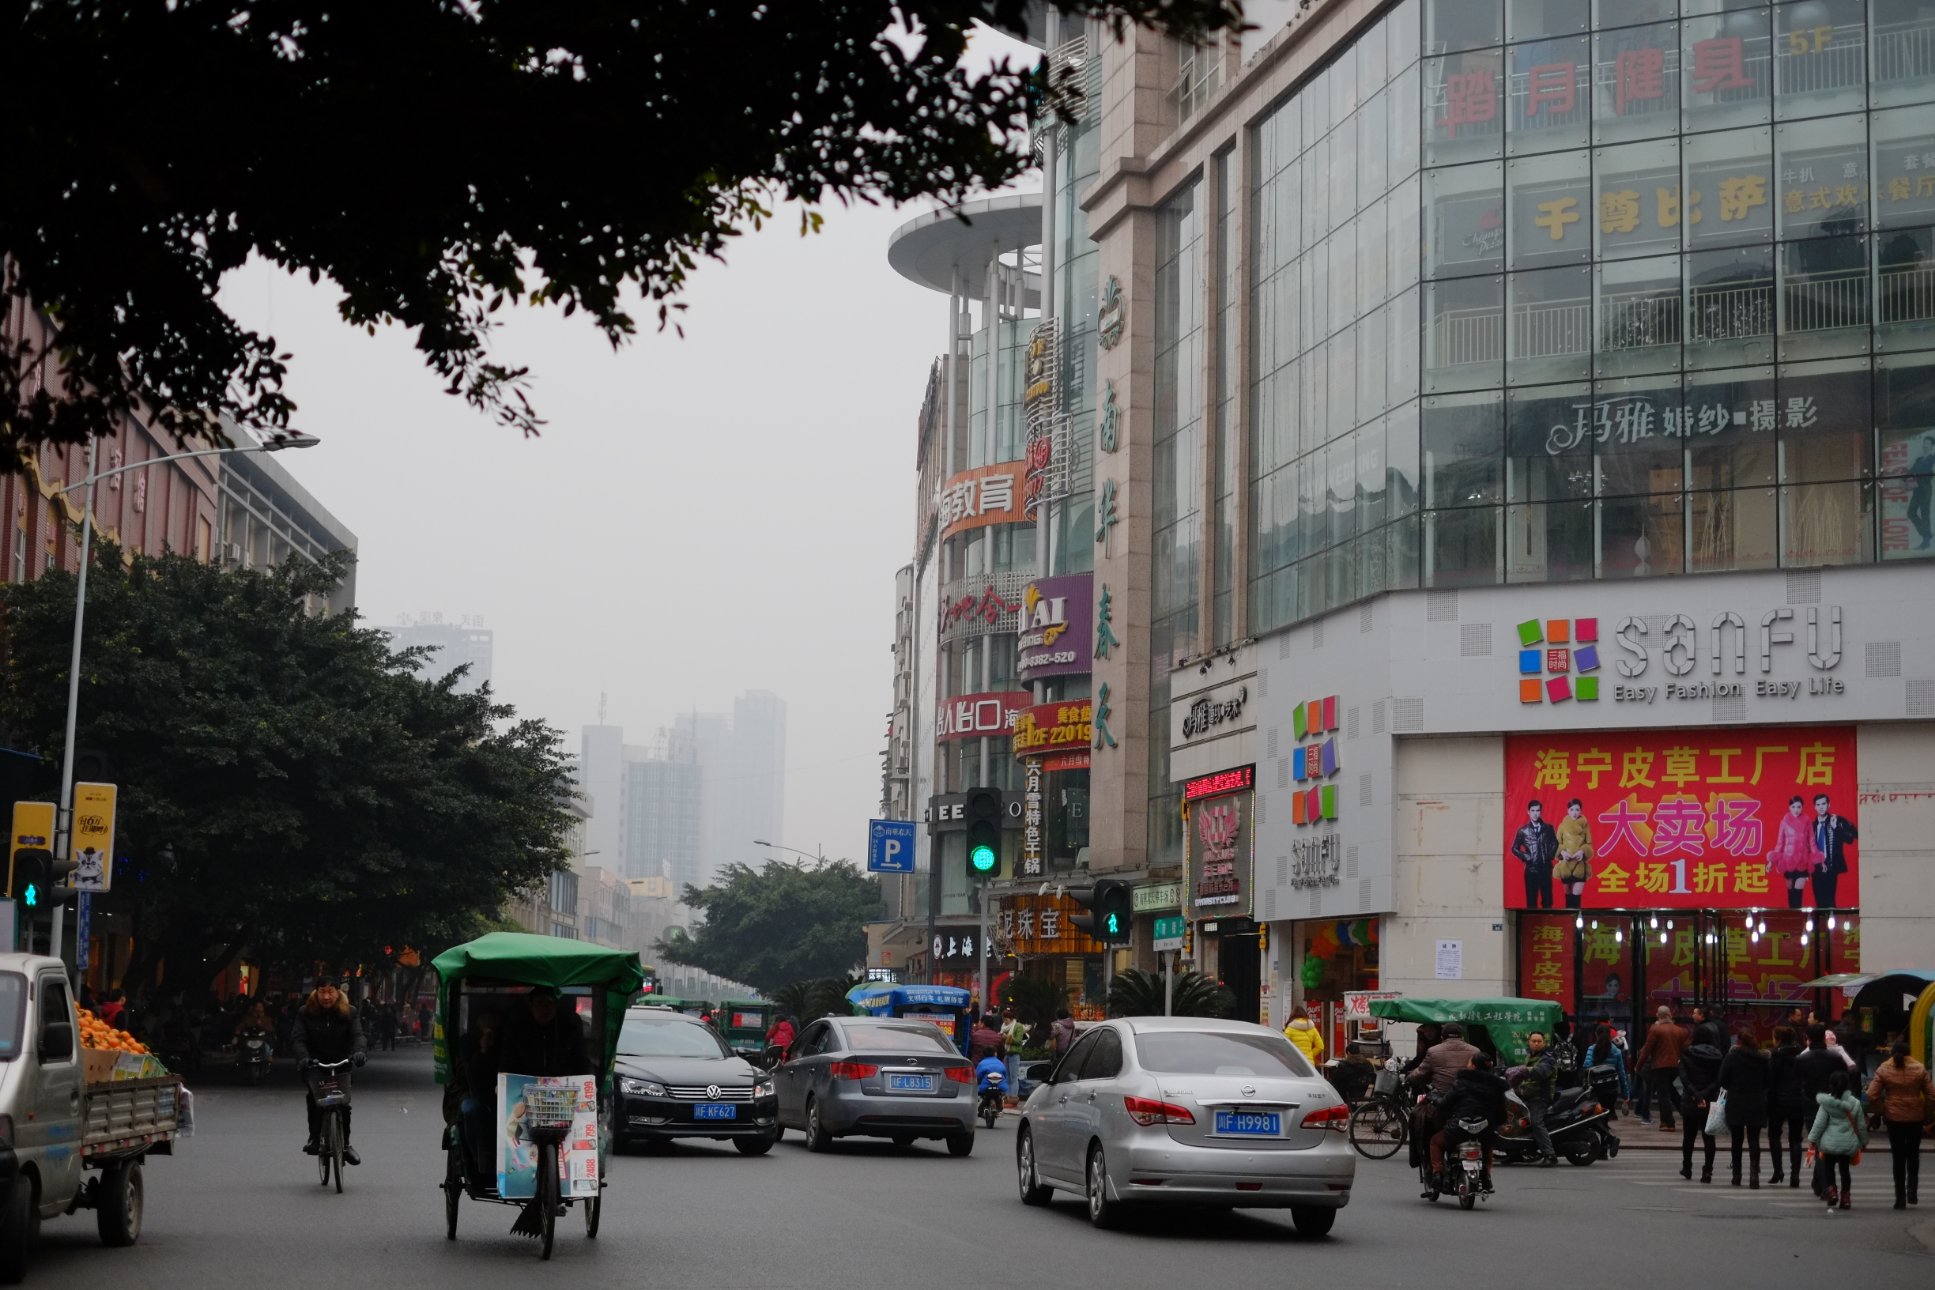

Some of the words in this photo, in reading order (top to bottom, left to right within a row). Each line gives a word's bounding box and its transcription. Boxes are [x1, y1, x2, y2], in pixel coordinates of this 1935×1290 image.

[1789, 26, 1832, 55] 5F
[1534, 175, 1769, 241] 千尊比萨
[1882, 518, 1909, 550] LOVE
[1614, 684, 1657, 704] Easy
[1665, 681, 1741, 699] Fashion
[1755, 679, 1801, 699] Easy
[1809, 677, 1844, 695] Life
[1534, 742, 1836, 790] 海宁皮草工厂店
[1024, 760, 1042, 874] 六月雪特色干锅
[1597, 799, 1763, 857] 大卖场
[885, 839, 901, 862] P
[1597, 858, 1769, 894] 全场1折起
[1532, 924, 1564, 995] 海宁皮草
